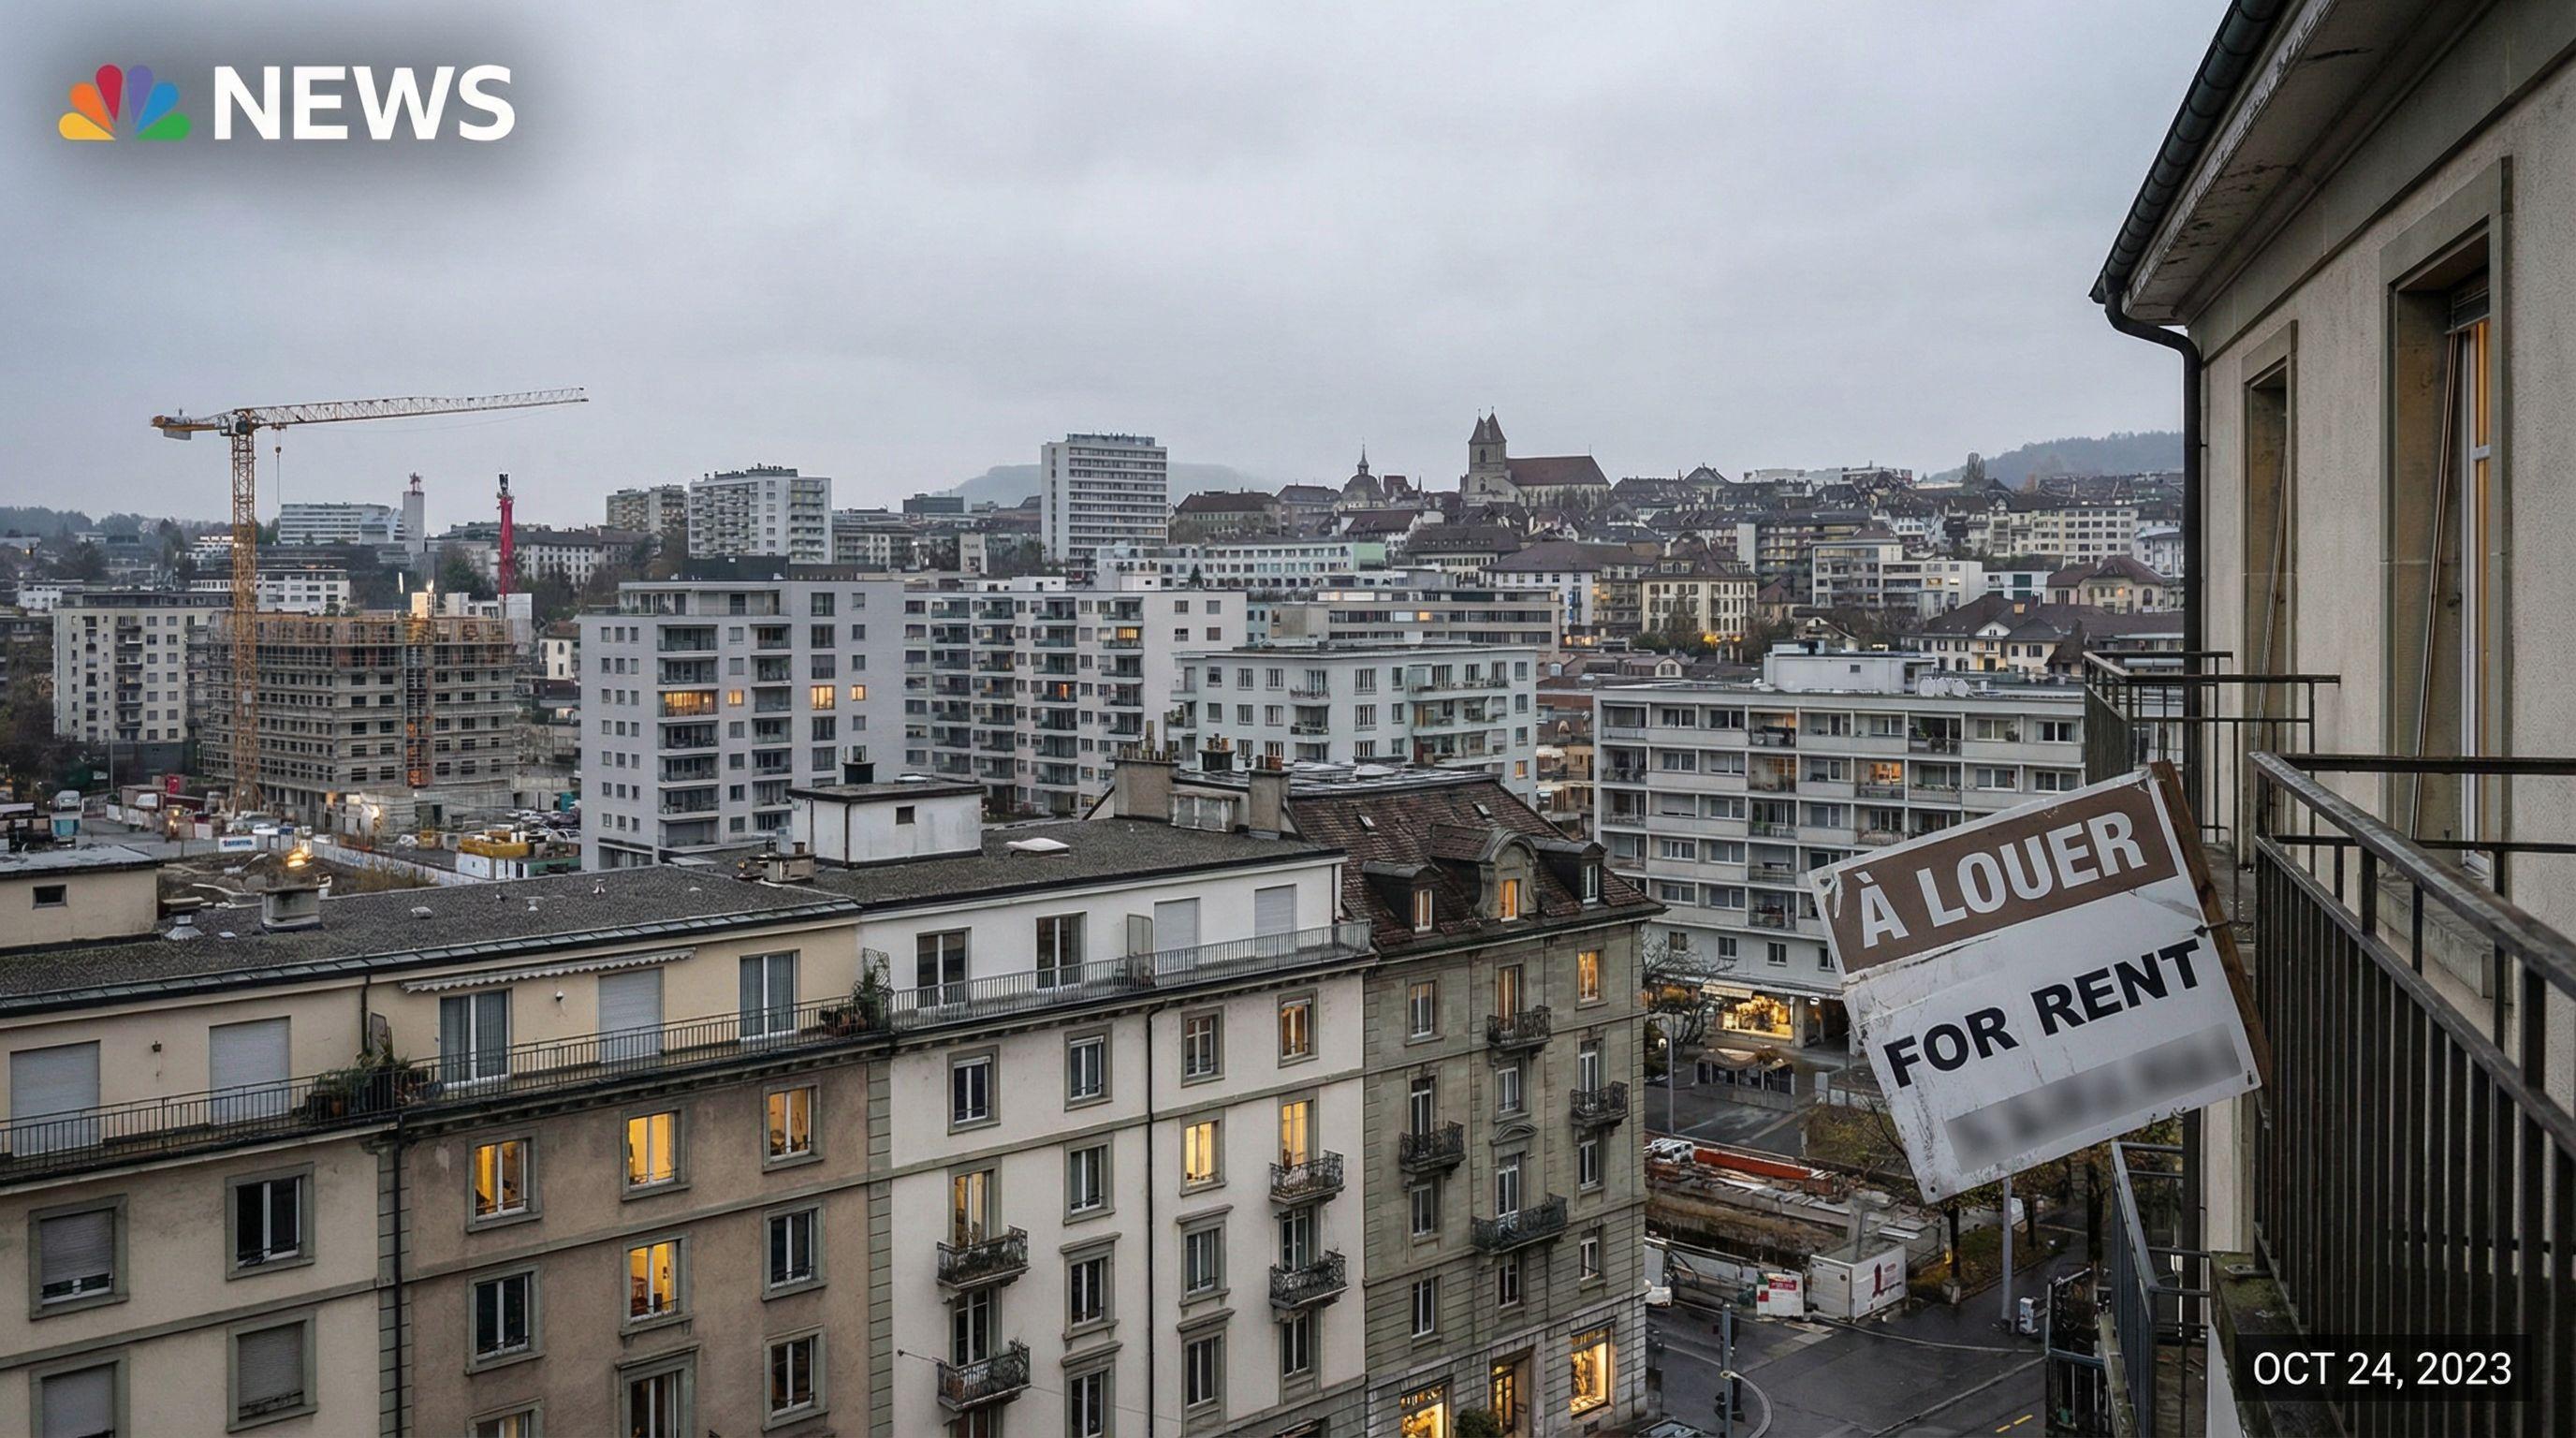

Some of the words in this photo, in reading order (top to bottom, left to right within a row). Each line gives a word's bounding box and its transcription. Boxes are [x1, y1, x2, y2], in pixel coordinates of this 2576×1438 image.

[1855, 871, 1910, 949] À
[1916, 811, 2148, 928] LOUER
[1881, 1006, 2021, 1089] FOR
[2029, 937, 2202, 1036] RENT
